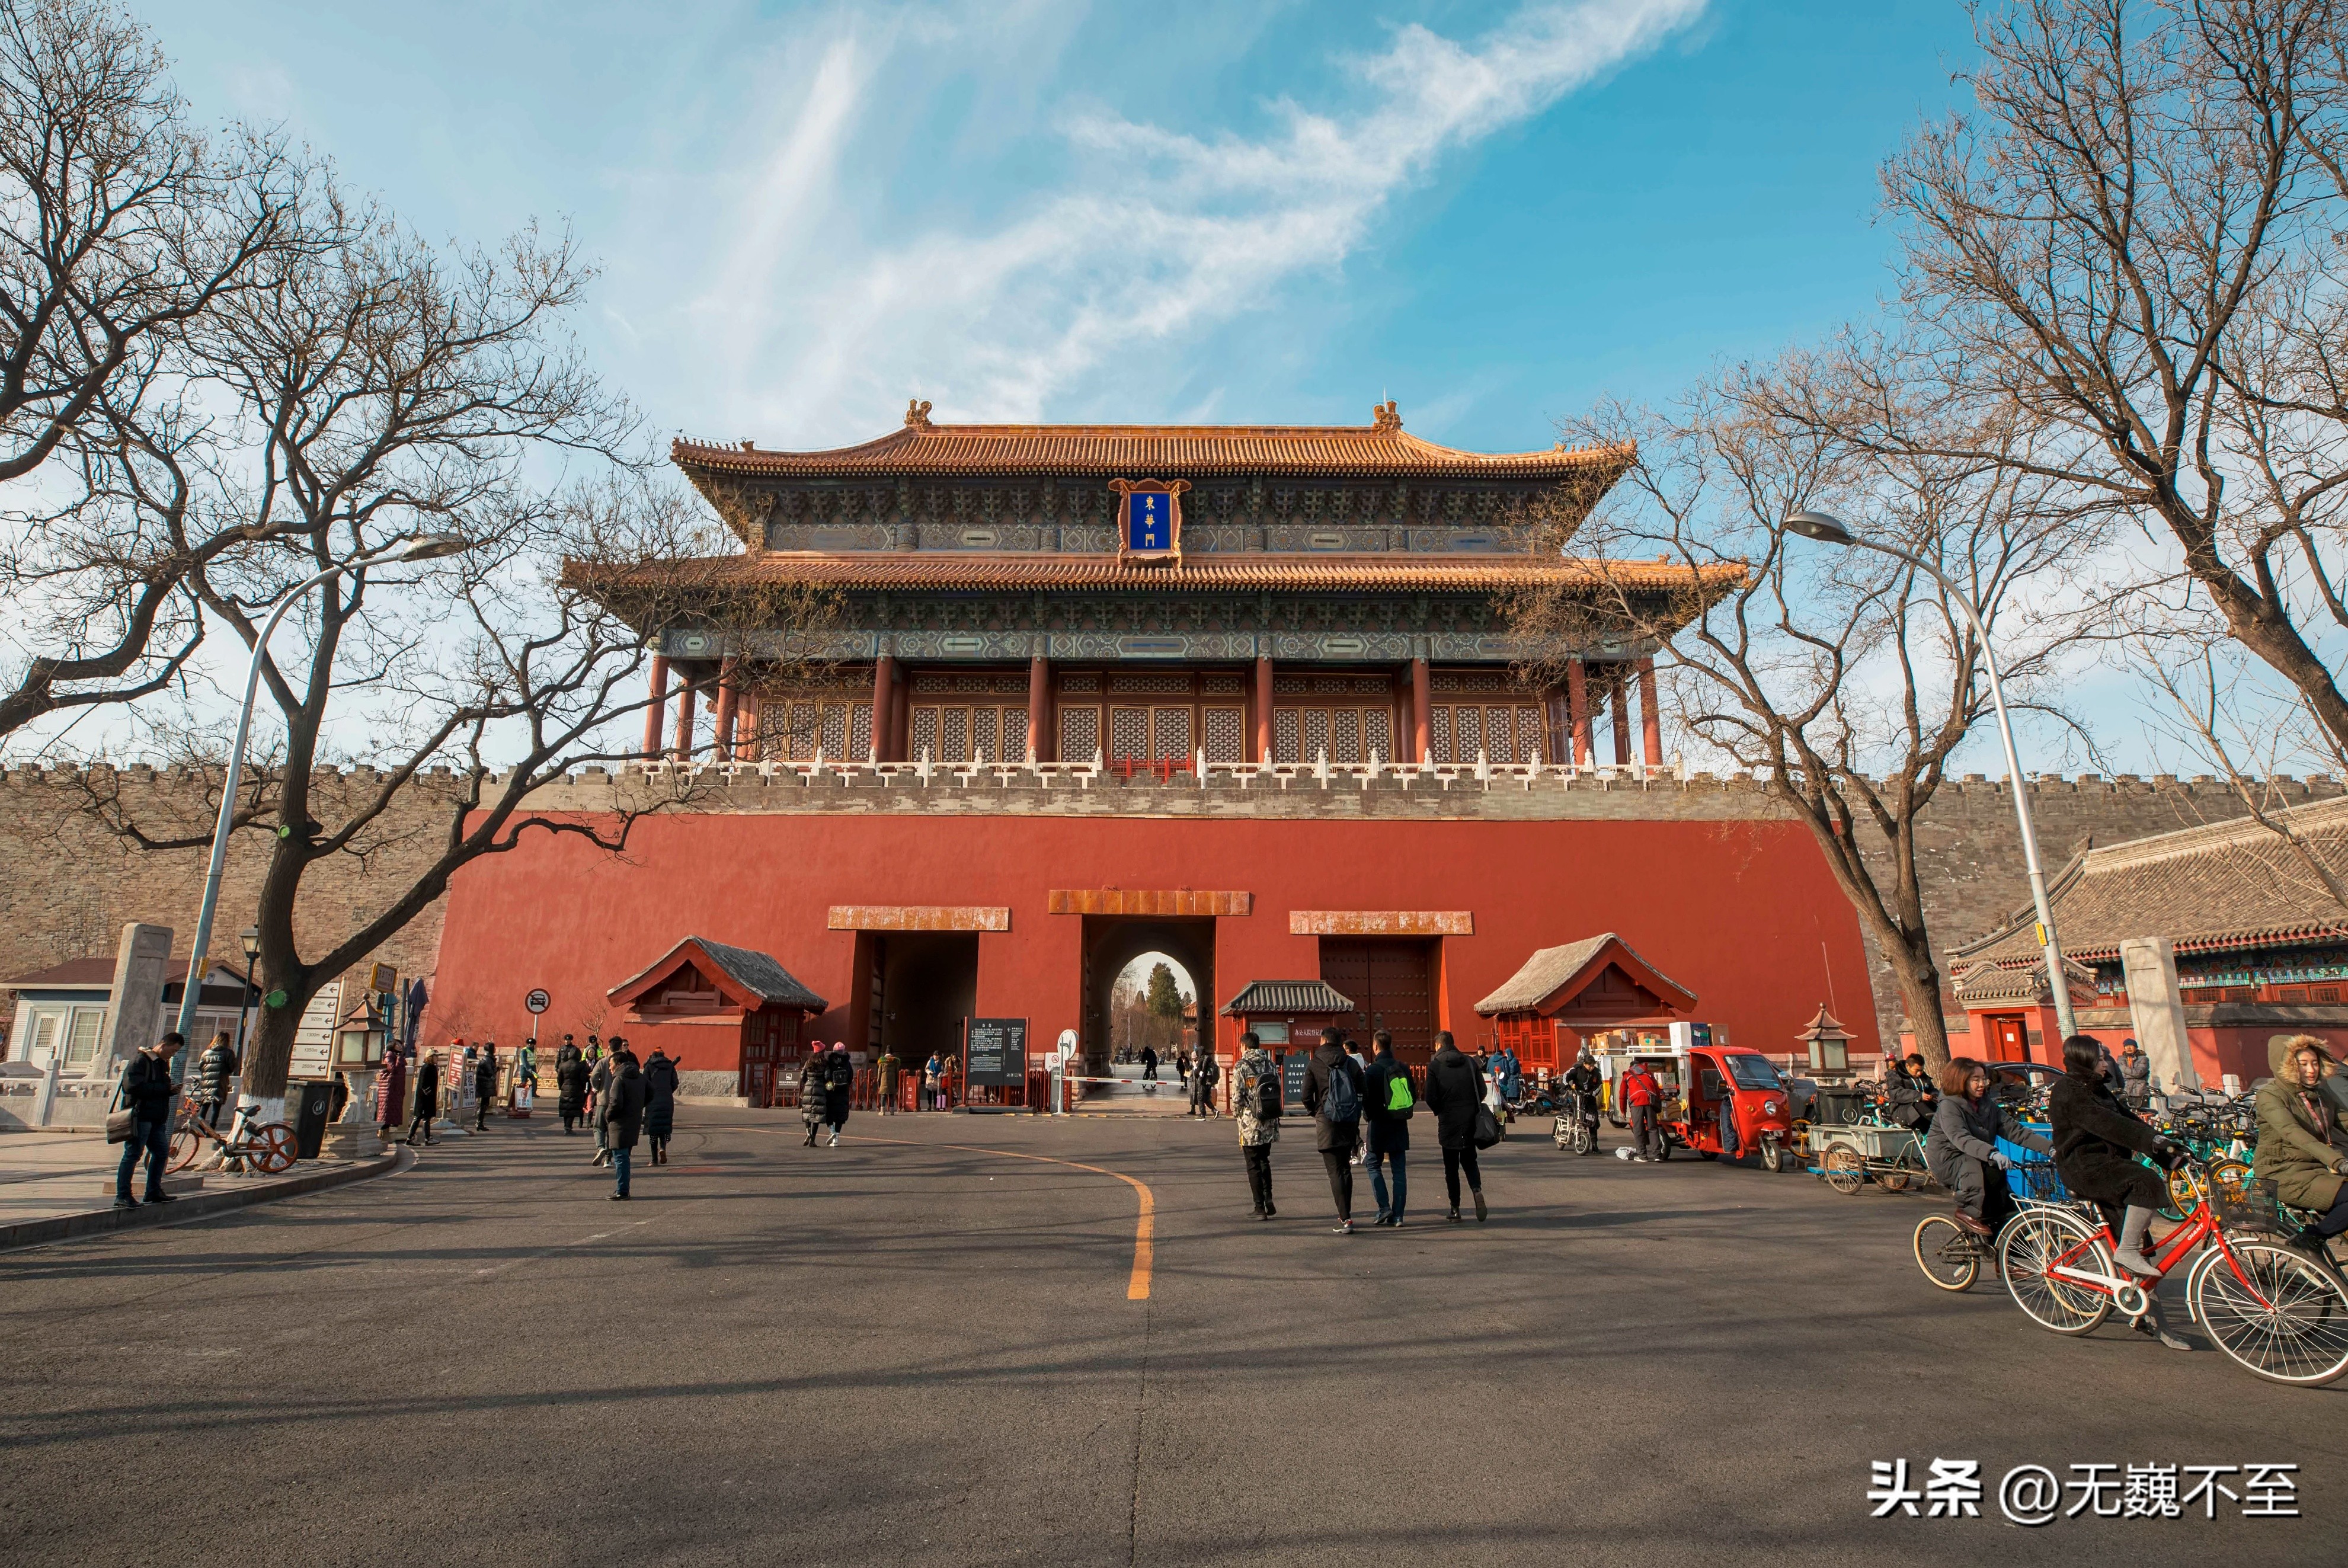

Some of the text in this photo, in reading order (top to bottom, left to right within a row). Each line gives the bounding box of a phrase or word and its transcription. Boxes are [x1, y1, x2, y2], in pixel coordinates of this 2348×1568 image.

[1144, 495, 1156, 547] 東華門
[2187, 1223, 2203, 1240] GIANT
